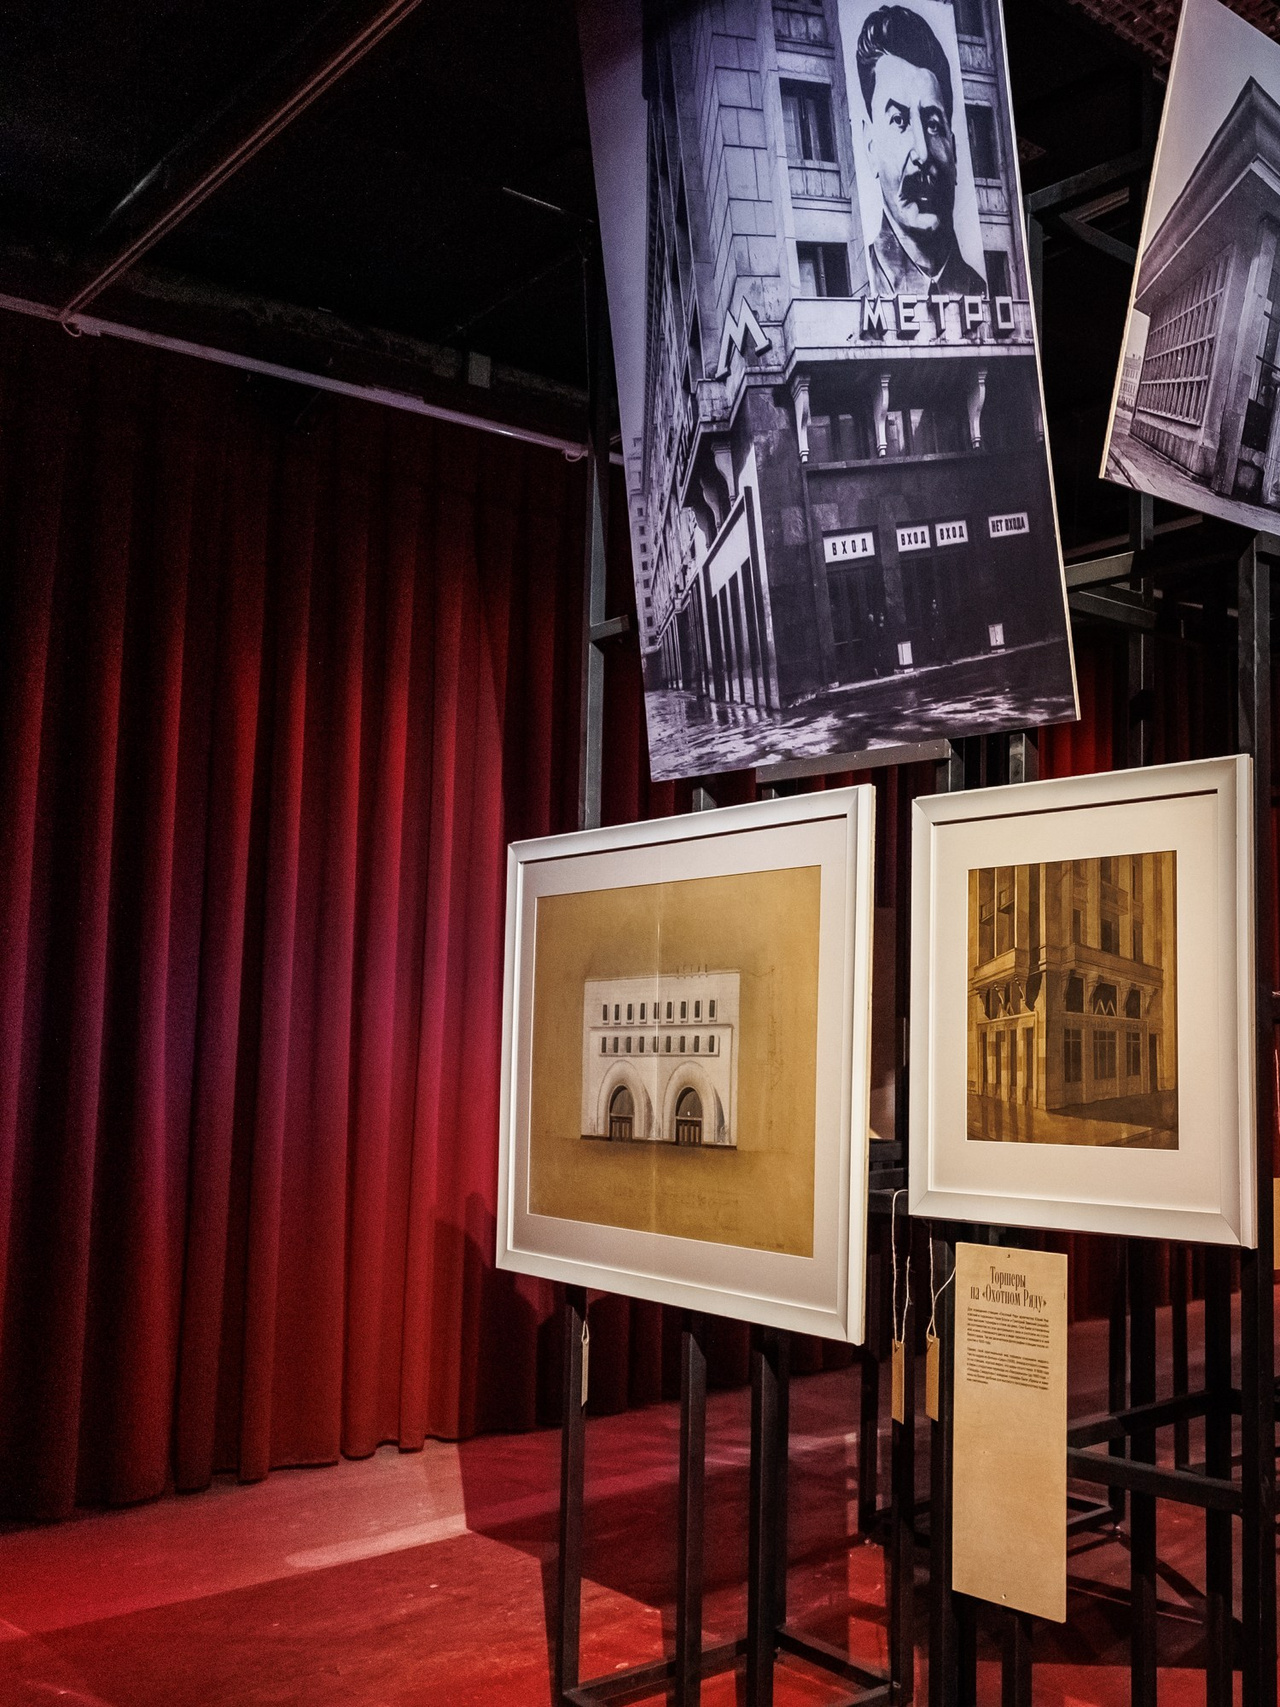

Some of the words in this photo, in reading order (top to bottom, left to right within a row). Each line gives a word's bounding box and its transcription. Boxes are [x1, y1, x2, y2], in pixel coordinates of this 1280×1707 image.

[860, 293, 1015, 340] МЕТРО
[715, 295, 771, 379] М
[939, 525, 964, 541] ВХОД
[991, 518, 1003, 533] НЕТ
[1005, 515, 1026, 531] ВХОДА
[831, 538, 868, 556] ВХОД
[900, 531, 927, 547] ВХОД
[989, 1265, 1026, 1291] Торшеры
[970, 1286, 980, 1300] на
[982, 1283, 1021, 1307] «Охотном
[1023, 1288, 1047, 1313] Ряду»
